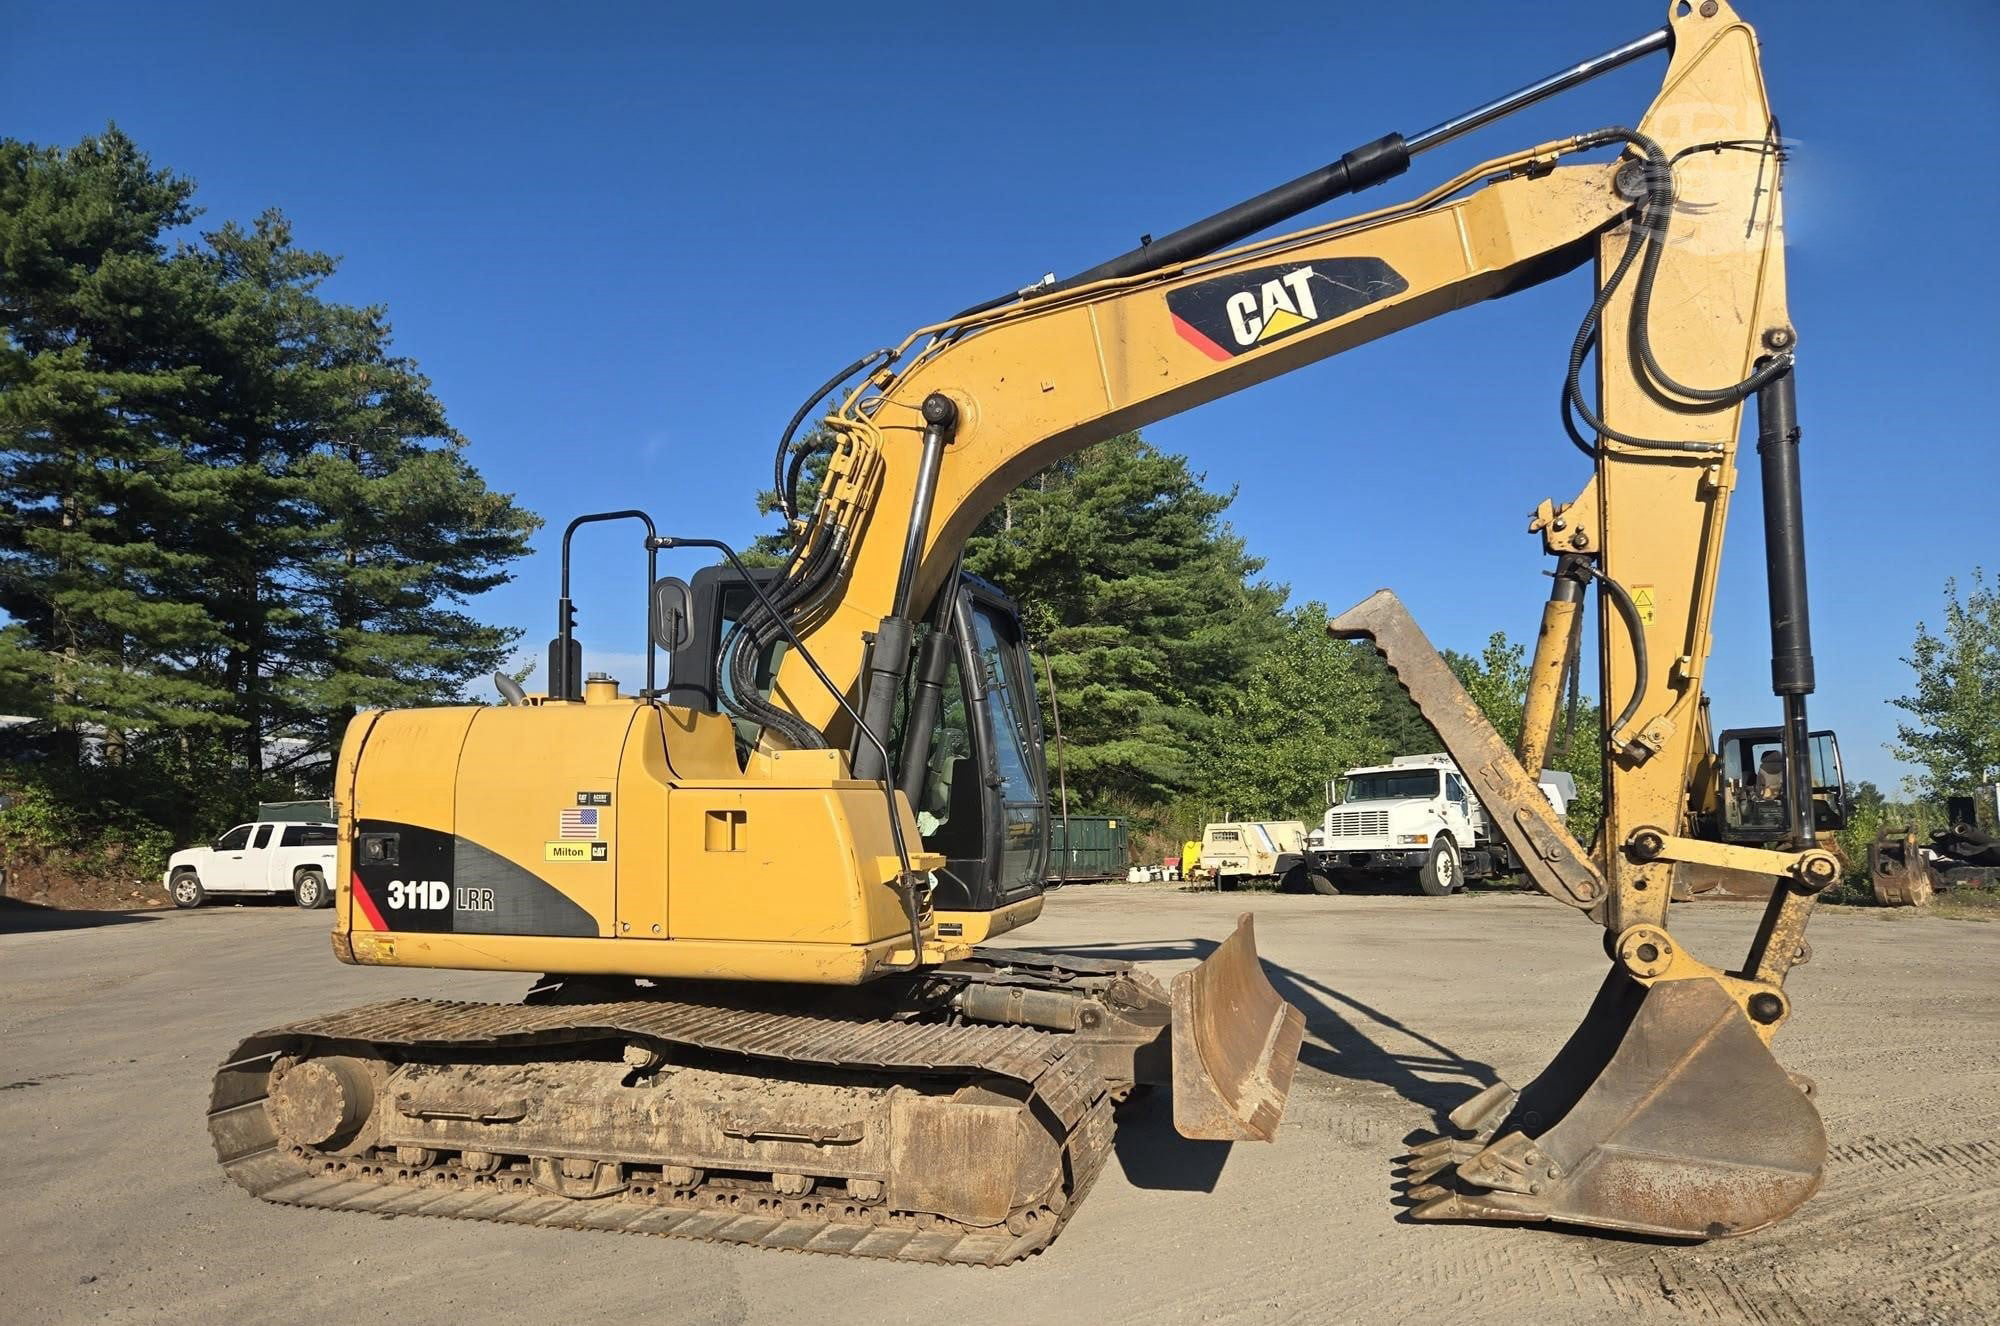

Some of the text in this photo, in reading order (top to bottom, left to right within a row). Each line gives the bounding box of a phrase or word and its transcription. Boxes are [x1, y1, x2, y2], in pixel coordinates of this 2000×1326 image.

[1225, 265, 1318, 346] CAT
[553, 847, 606, 857] Milton CAT
[387, 880, 494, 911] 311D LRR
